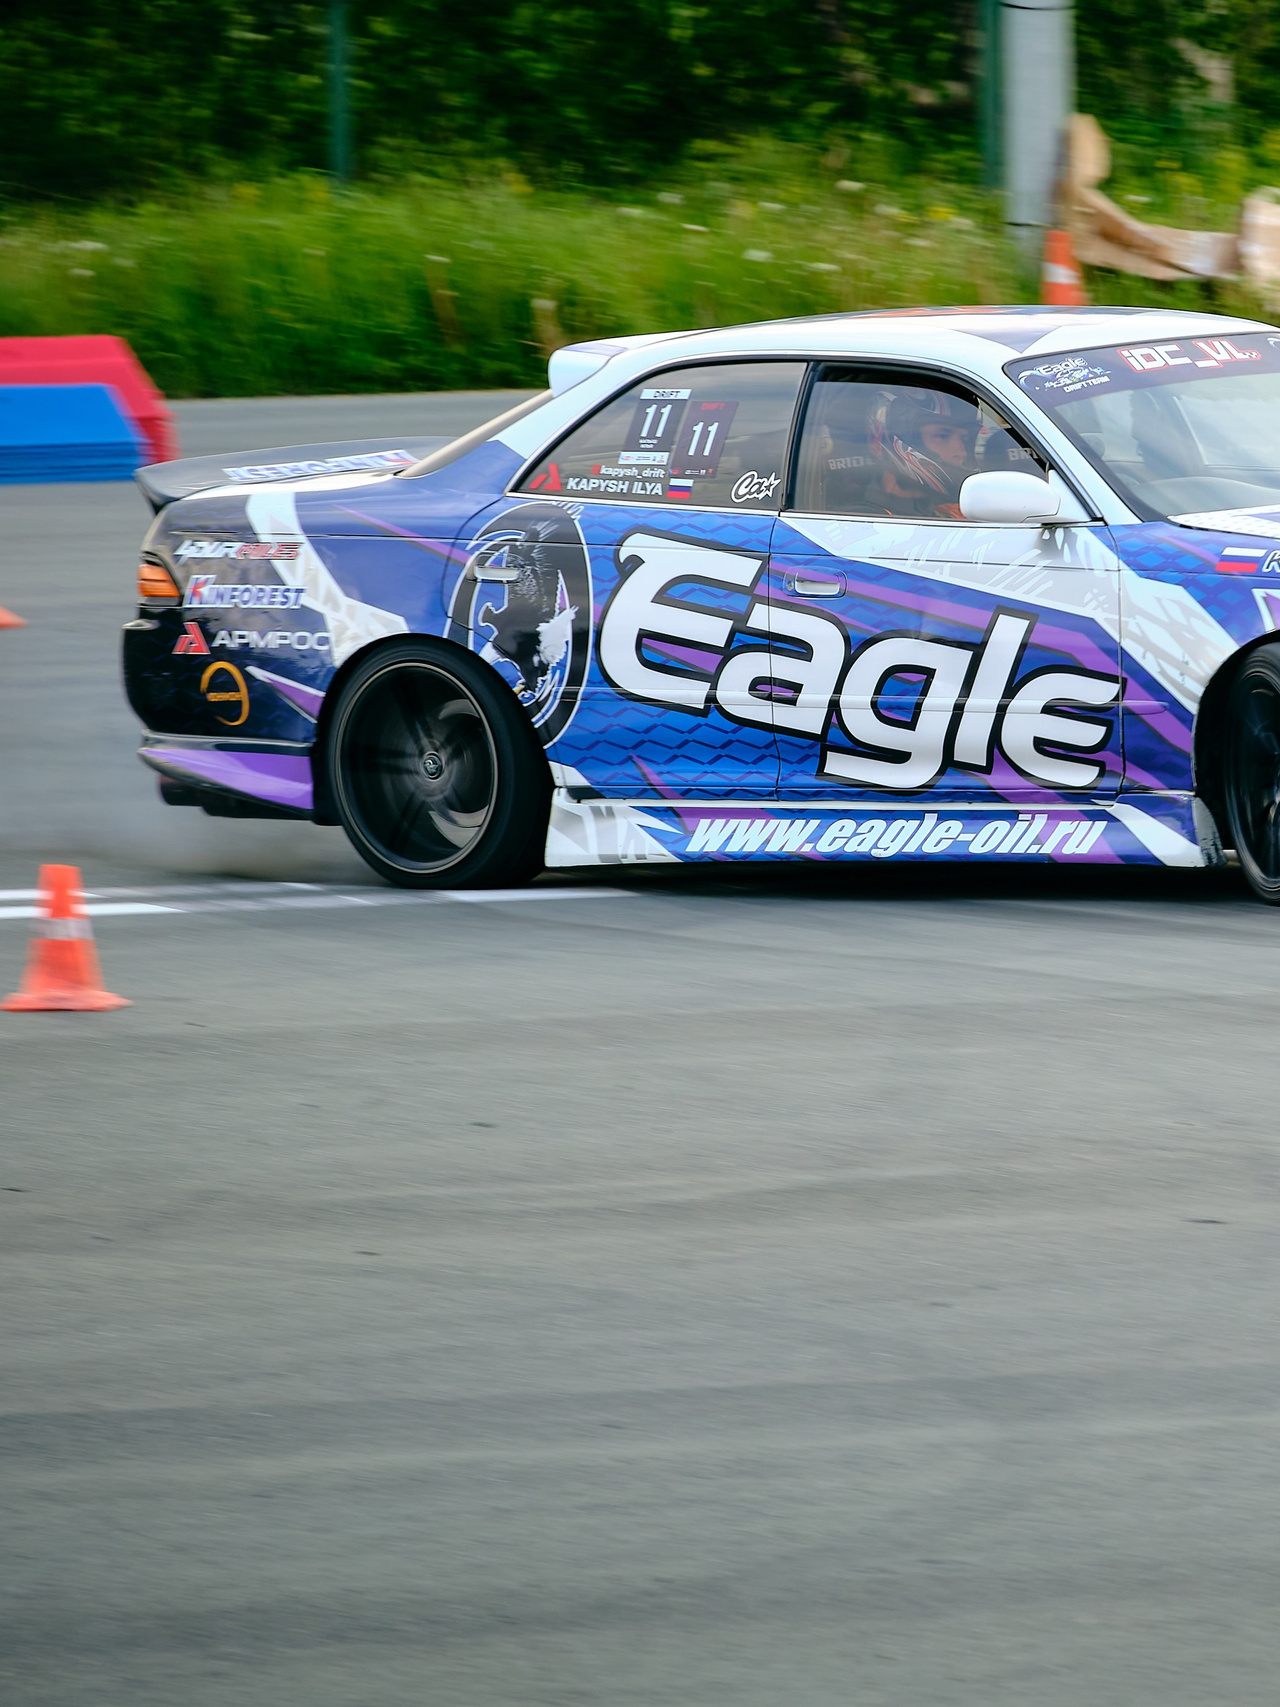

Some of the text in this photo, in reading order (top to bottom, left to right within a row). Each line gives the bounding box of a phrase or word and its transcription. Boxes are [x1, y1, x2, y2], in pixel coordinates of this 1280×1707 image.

[1034, 357, 1088, 375] Eagle
[1063, 376, 1110, 393] DRIFT TEAM
[653, 391, 681, 399] DRIFT
[640, 403, 673, 438] 11
[688, 421, 719, 457] 11
[600, 465, 665, 478] kapysh_drift
[566, 478, 663, 496] KAPYSH ILYA
[597, 528, 1125, 793] Eagle
[685, 813, 1108, 858] www.eagle-oil.ru
